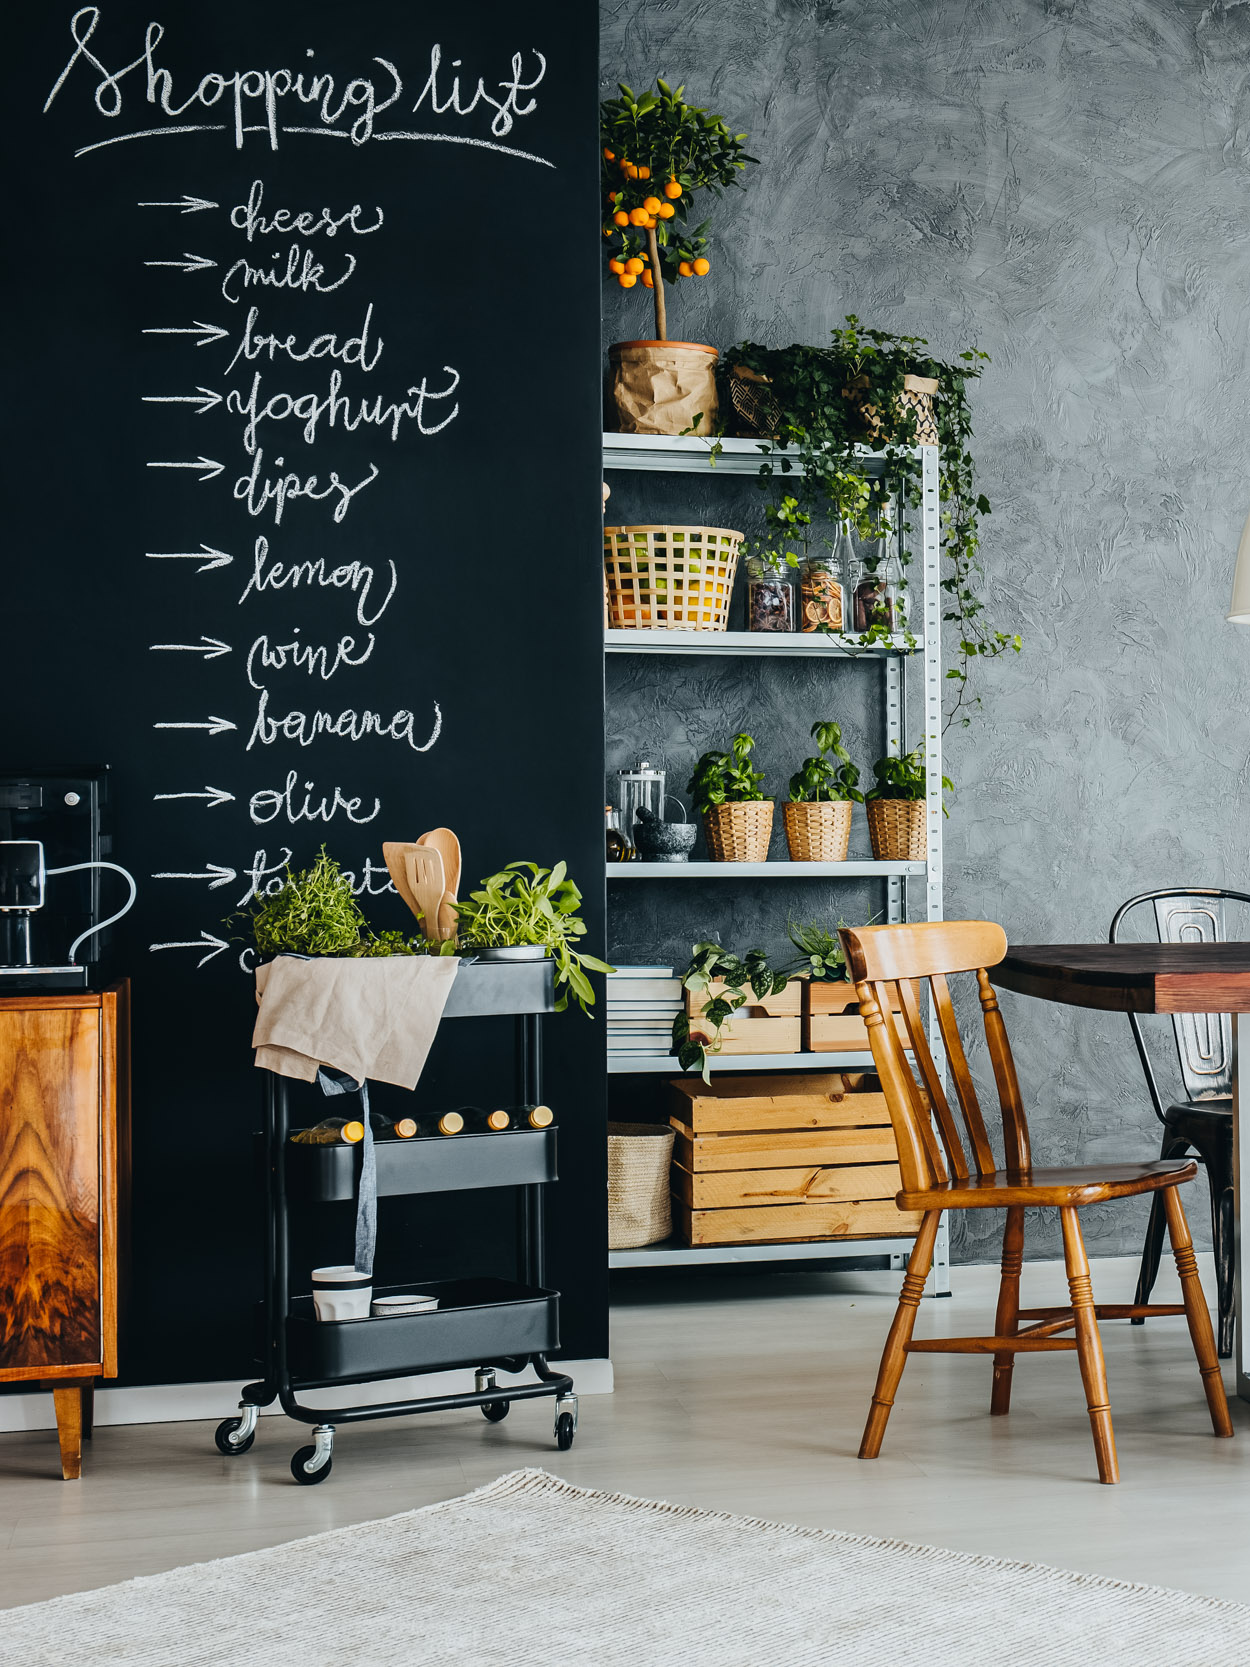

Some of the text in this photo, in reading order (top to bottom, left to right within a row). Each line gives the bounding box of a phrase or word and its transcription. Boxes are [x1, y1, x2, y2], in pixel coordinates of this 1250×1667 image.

[43, 6, 547, 151] Shopping list
[230, 179, 384, 242] cheese
[221, 243, 357, 304] milk
[223, 302, 385, 376] bread
[238, 535, 398, 626] lemon
[246, 627, 376, 690] wine
[245, 689, 443, 753] banana
[249, 769, 381, 824] olive
